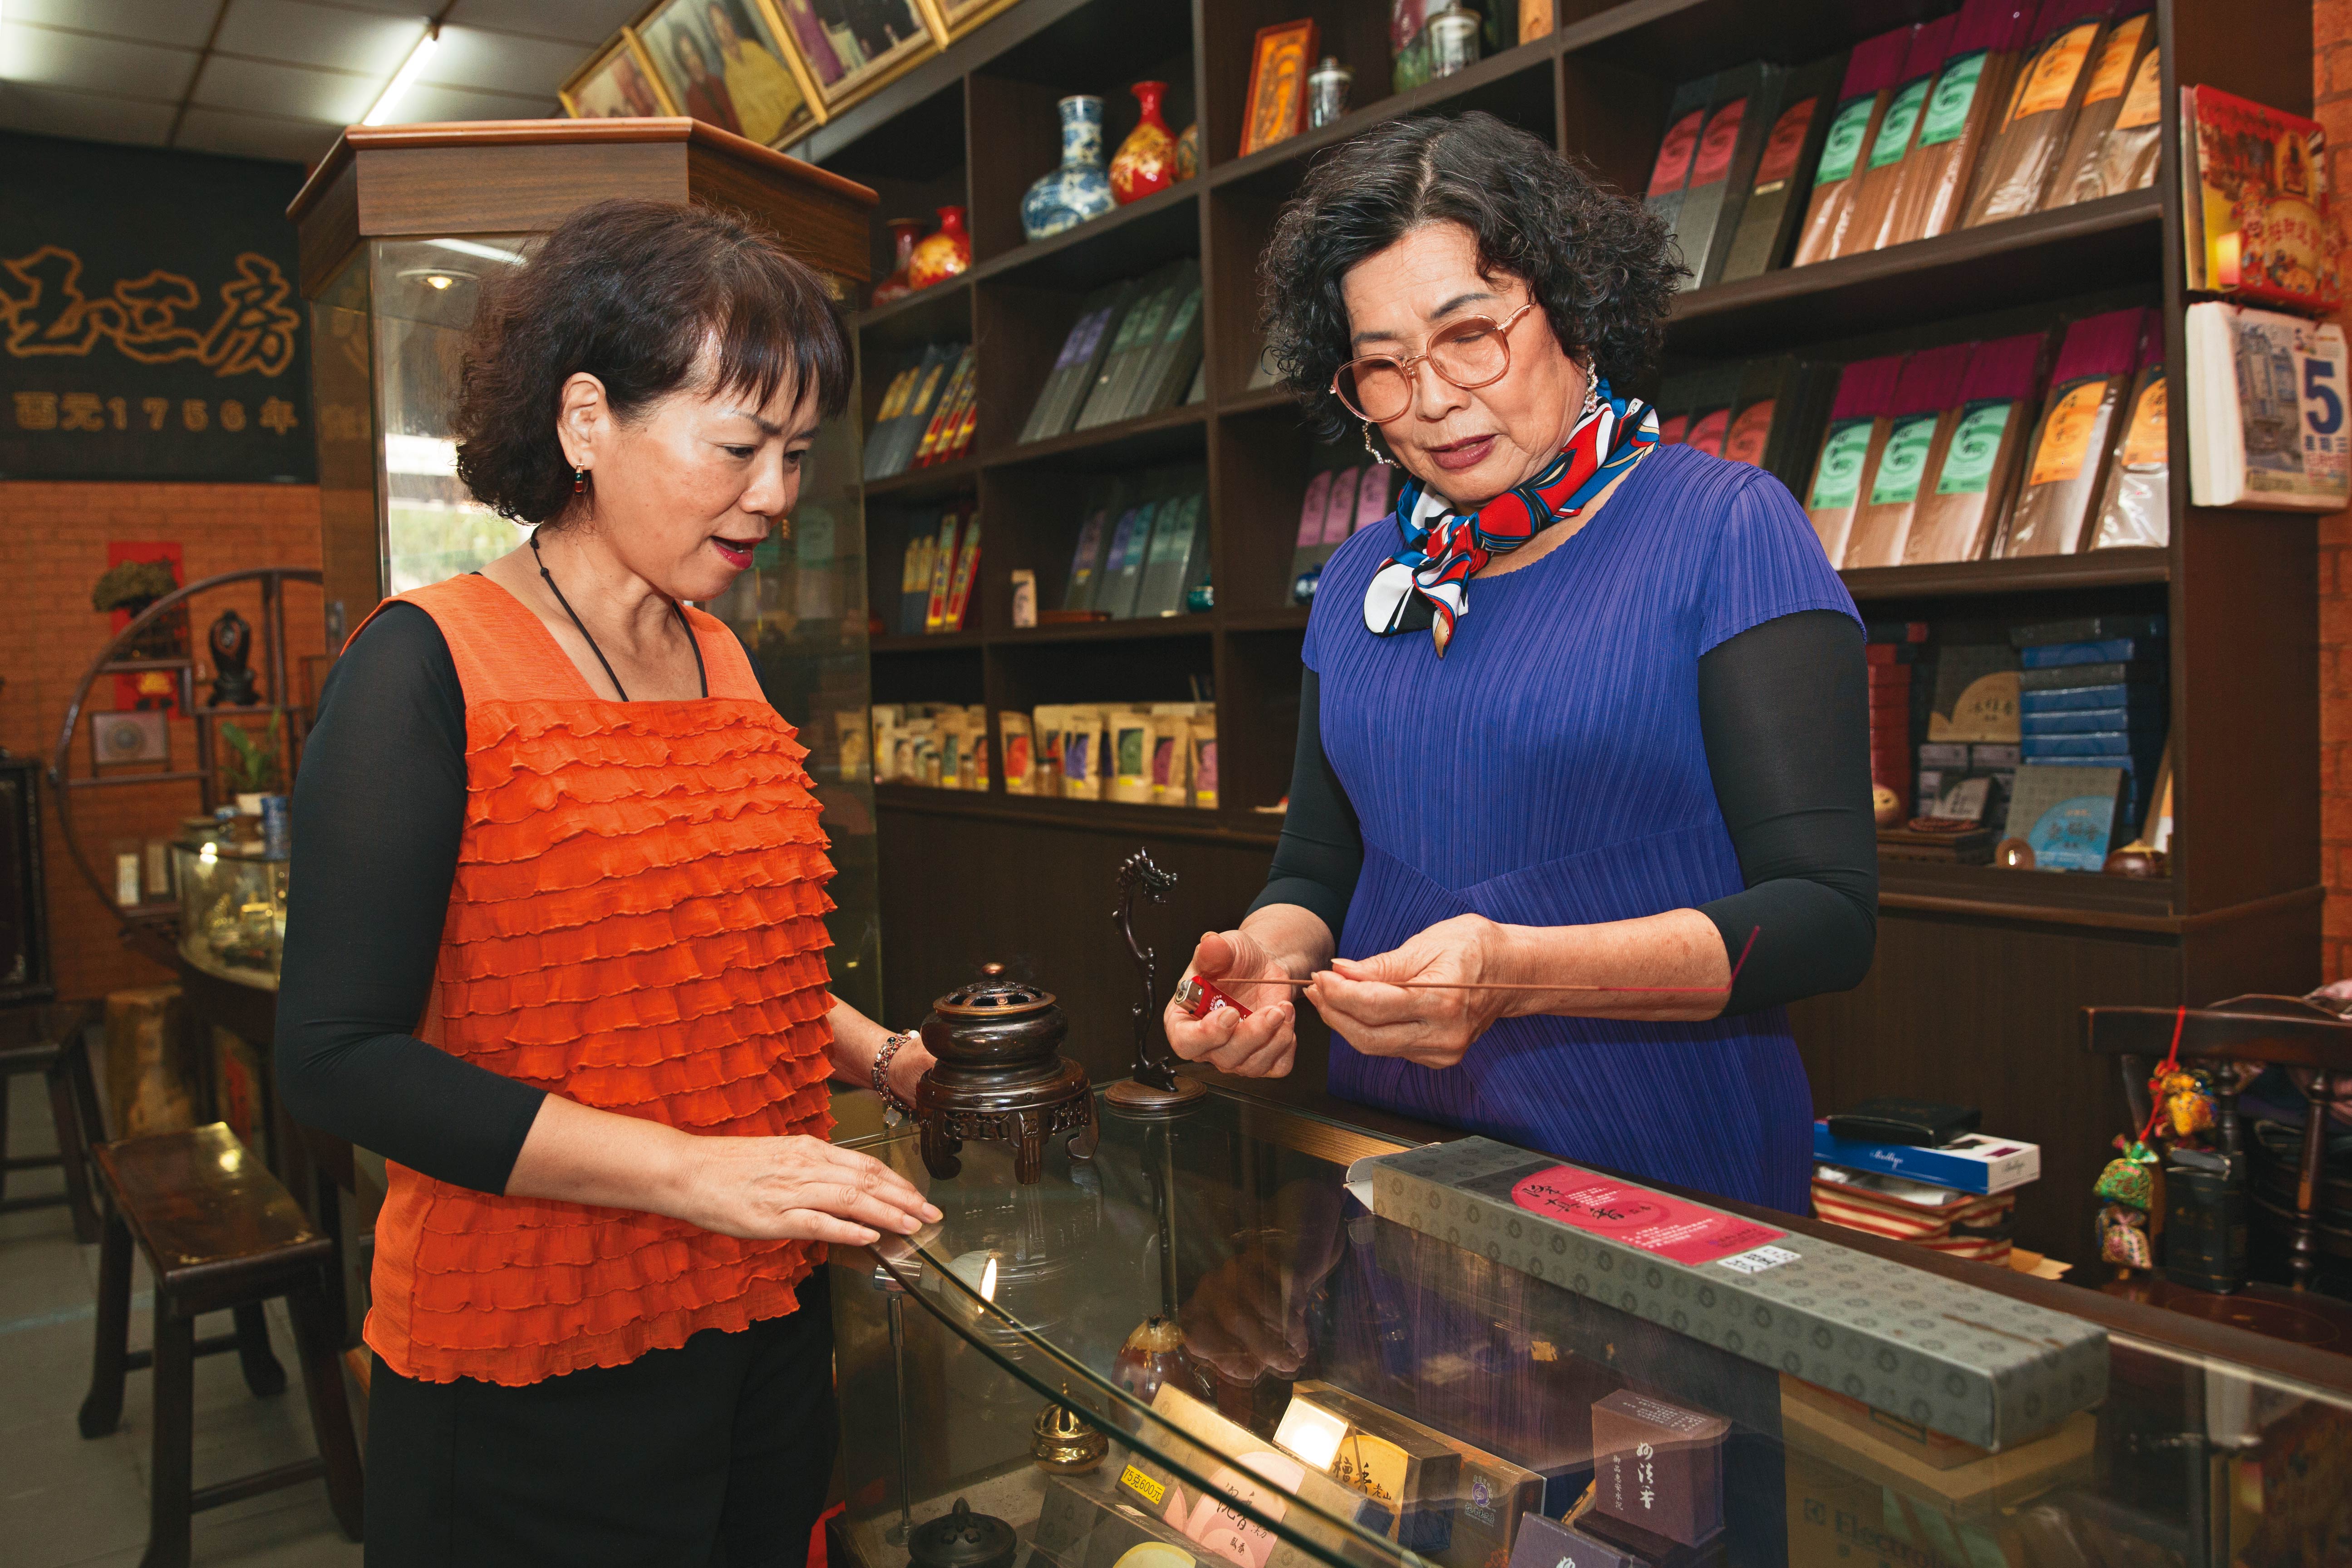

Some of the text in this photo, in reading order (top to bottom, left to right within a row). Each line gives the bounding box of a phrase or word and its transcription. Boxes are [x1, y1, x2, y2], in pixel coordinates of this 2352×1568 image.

[2304, 358, 2343, 435] 5
[1124, 1468, 1163, 1501] 75克600元
[1372, 1483, 1392, 1500] 老山
[1636, 1442, 1655, 1509] 妙法香
